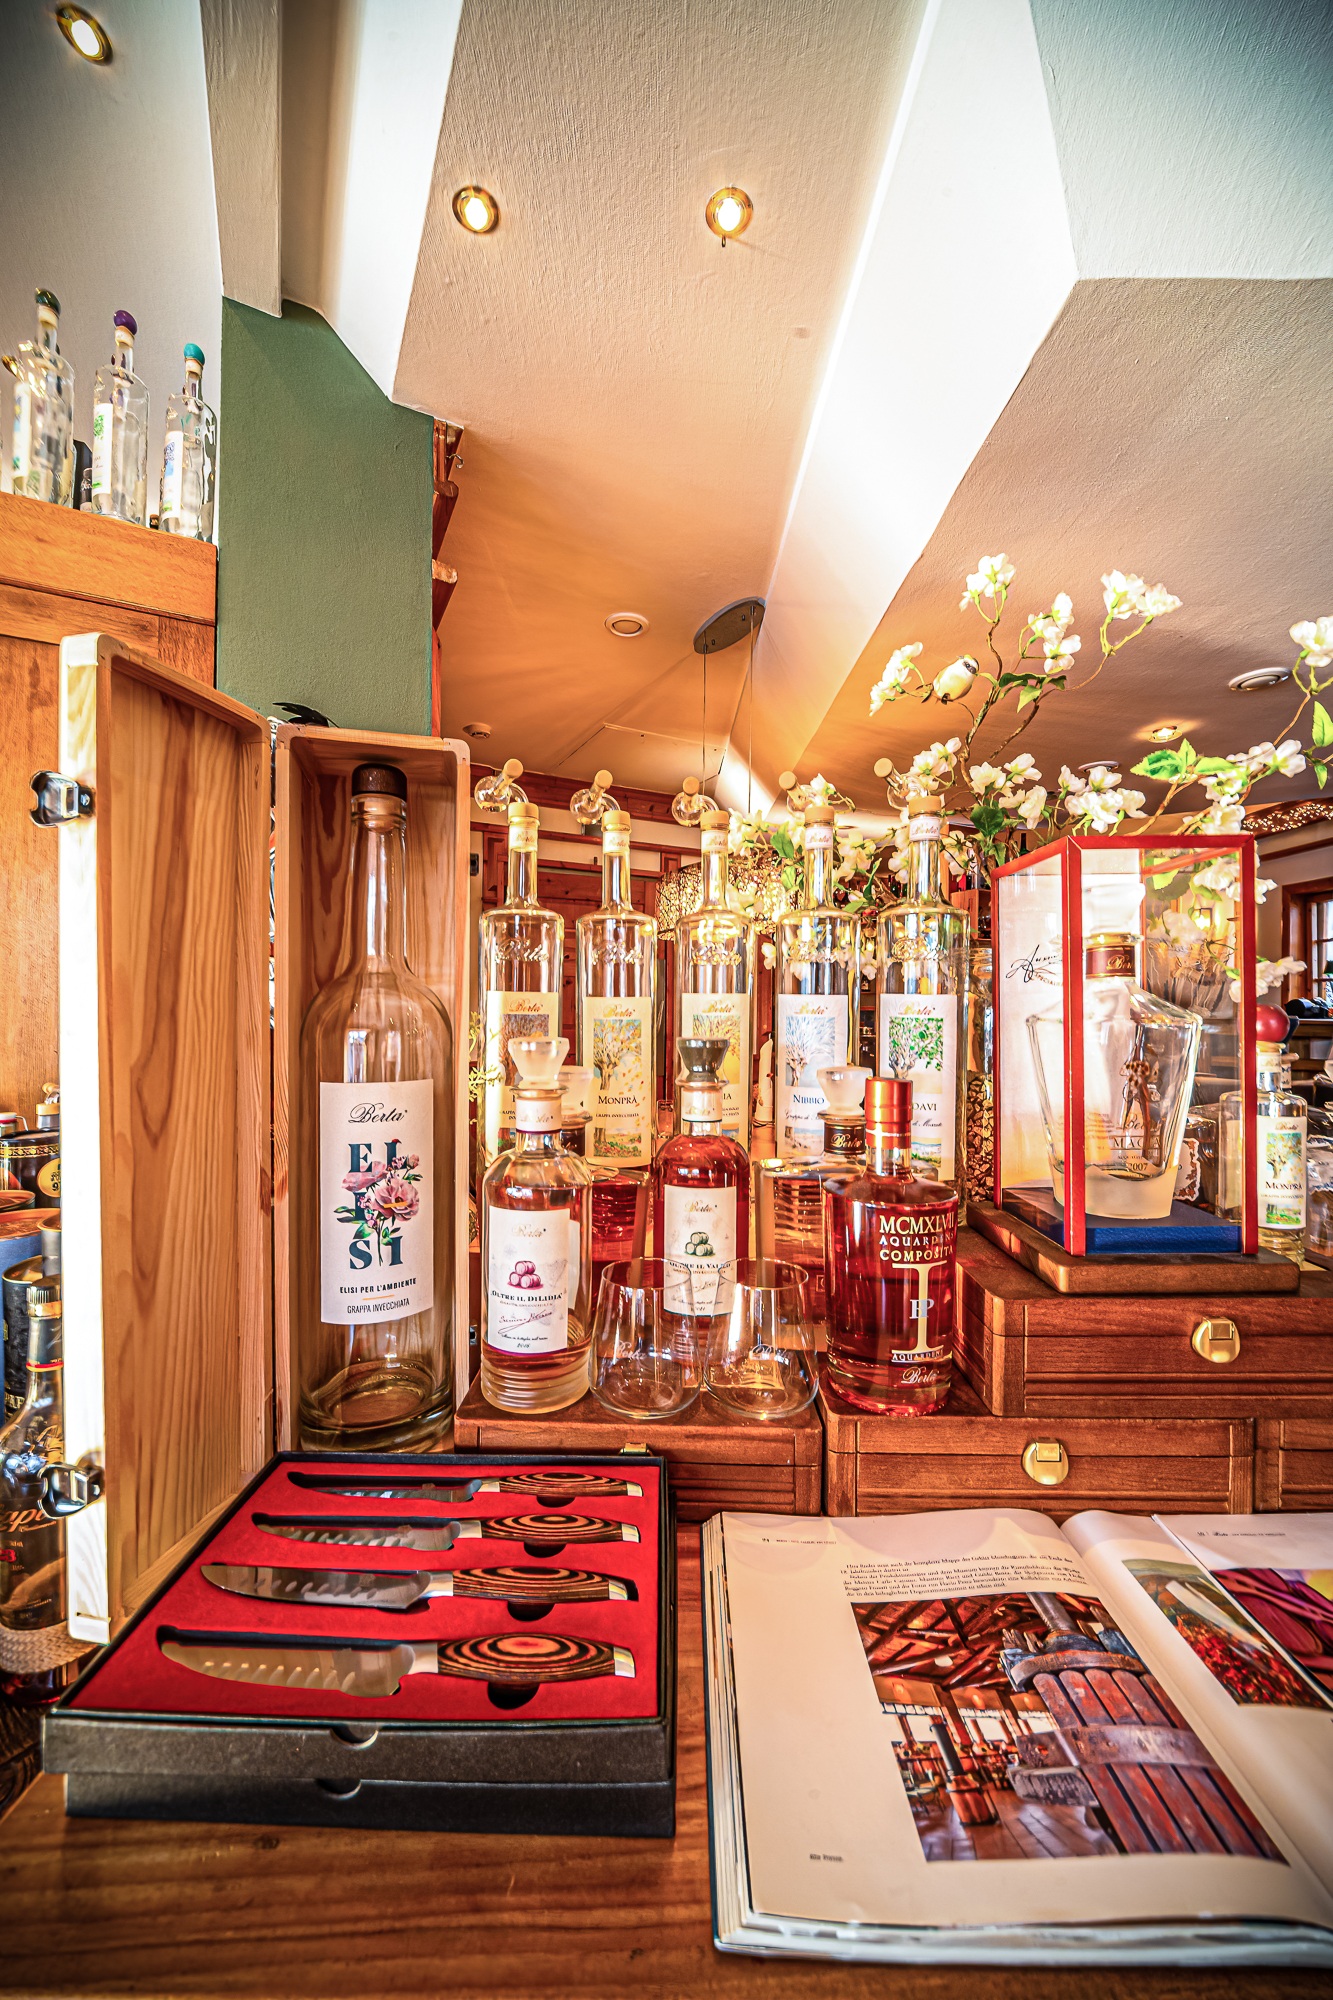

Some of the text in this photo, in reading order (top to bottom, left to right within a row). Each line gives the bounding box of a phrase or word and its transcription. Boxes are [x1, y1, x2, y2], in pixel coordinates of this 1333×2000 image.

[339, 1277, 417, 1294] ELISI PER L'AMBIENTE
[347, 1298, 410, 1314] GRAPPA INVECCHIATA
